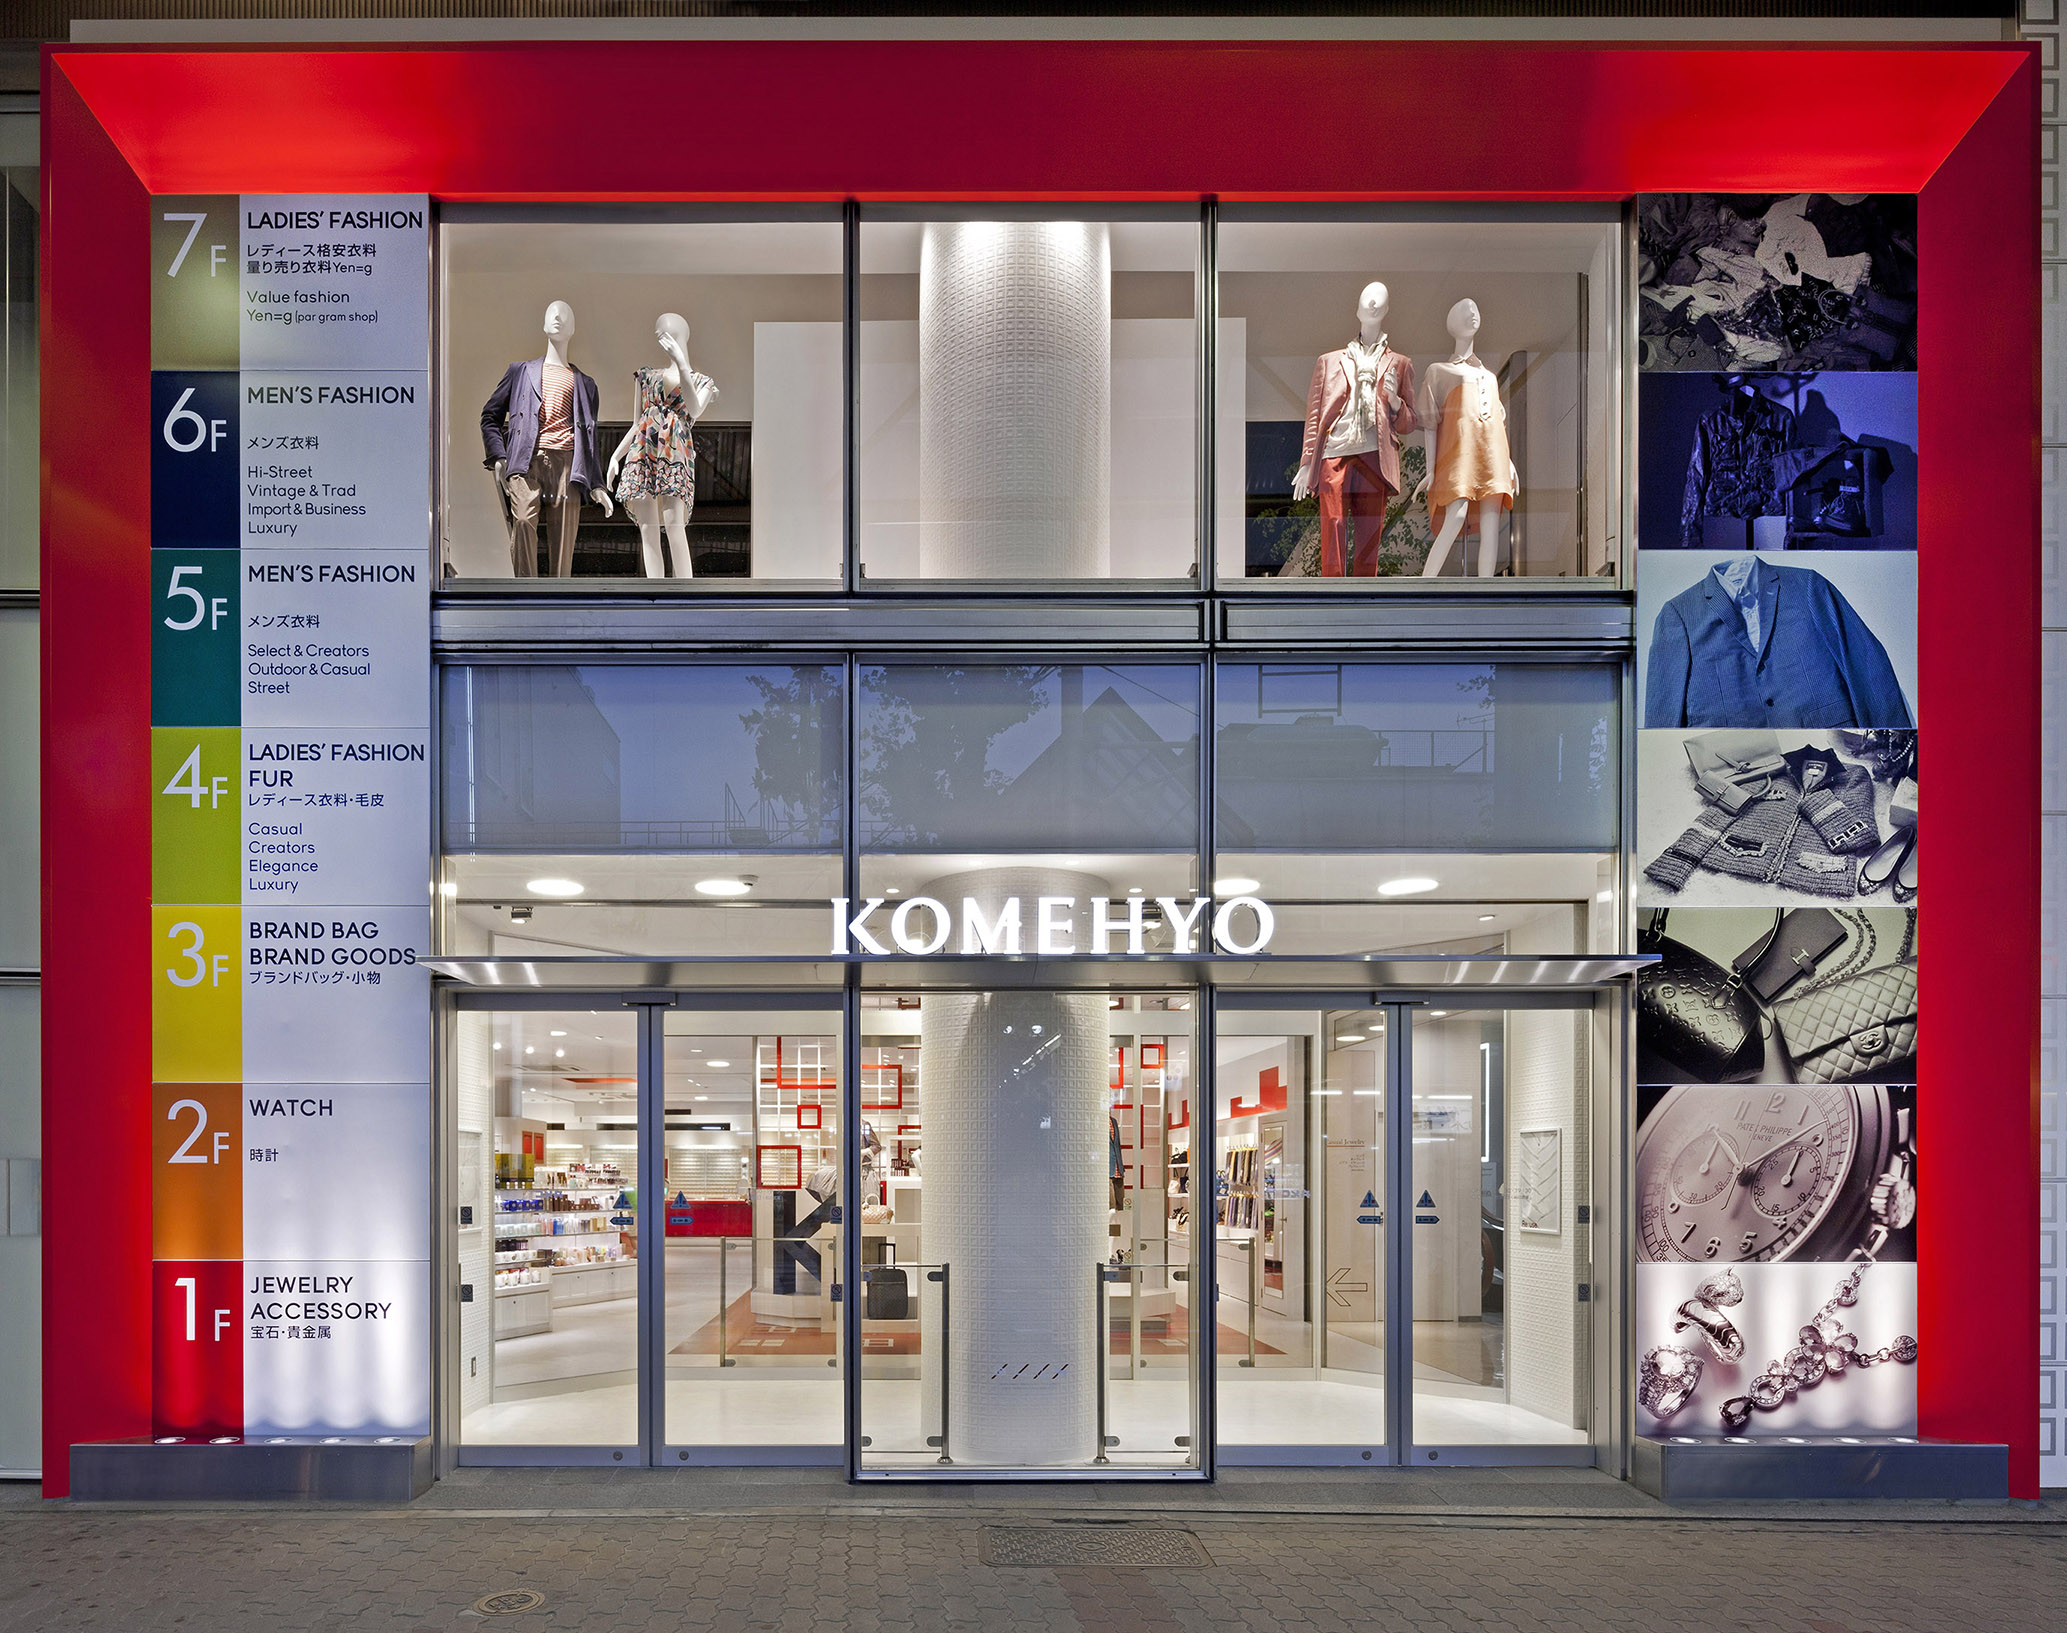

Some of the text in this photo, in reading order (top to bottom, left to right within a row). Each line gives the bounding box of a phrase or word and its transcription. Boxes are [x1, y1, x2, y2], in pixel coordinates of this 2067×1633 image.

[247, 211, 423, 230] LADIES' FASHION
[163, 212, 227, 278] 7F
[247, 243, 377, 258] レディース格安衣料
[247, 290, 350, 303] Value fashion
[246, 310, 293, 325] Yen=g
[318, 313, 347, 324] gram
[348, 310, 379, 324] shop)
[248, 386, 415, 404] MEN'S FASHION
[163, 387, 227, 452] 6F
[247, 436, 319, 451] メンズ衣料
[248, 465, 313, 479] Hi-Street
[248, 484, 306, 498] Vintage
[321, 484, 356, 497] Trad
[248, 521, 298, 537] Luxury
[249, 565, 415, 583] MEN'S FASHION
[164, 565, 228, 631] 5F
[248, 615, 320, 629] メンズ衣料
[248, 644, 292, 657] Select
[305, 644, 370, 657] Creators
[248, 681, 290, 694] Street
[249, 743, 425, 762] LADIES' FASHION
[162, 743, 228, 809] 4F
[249, 770, 294, 788] FUR
[249, 822, 303, 835] Casual
[249, 841, 315, 854] Creators
[249, 859, 319, 875] Elegance
[249, 878, 299, 894] Luxury
[249, 921, 379, 939] BRAND BAG
[830, 896, 1275, 956] KOMEHYO
[167, 921, 229, 987] 3F
[249, 947, 416, 966] BRAND GOODS
[249, 1099, 334, 1117] WATCH
[167, 1099, 230, 1165] 2F
[1760, 1125, 1793, 1136] PHILIPPE
[249, 1148, 279, 1163] 時計
[250, 1276, 354, 1294] JEWELRY
[174, 1277, 230, 1342] 1F
[250, 1302, 392, 1320] ACCESSORY
